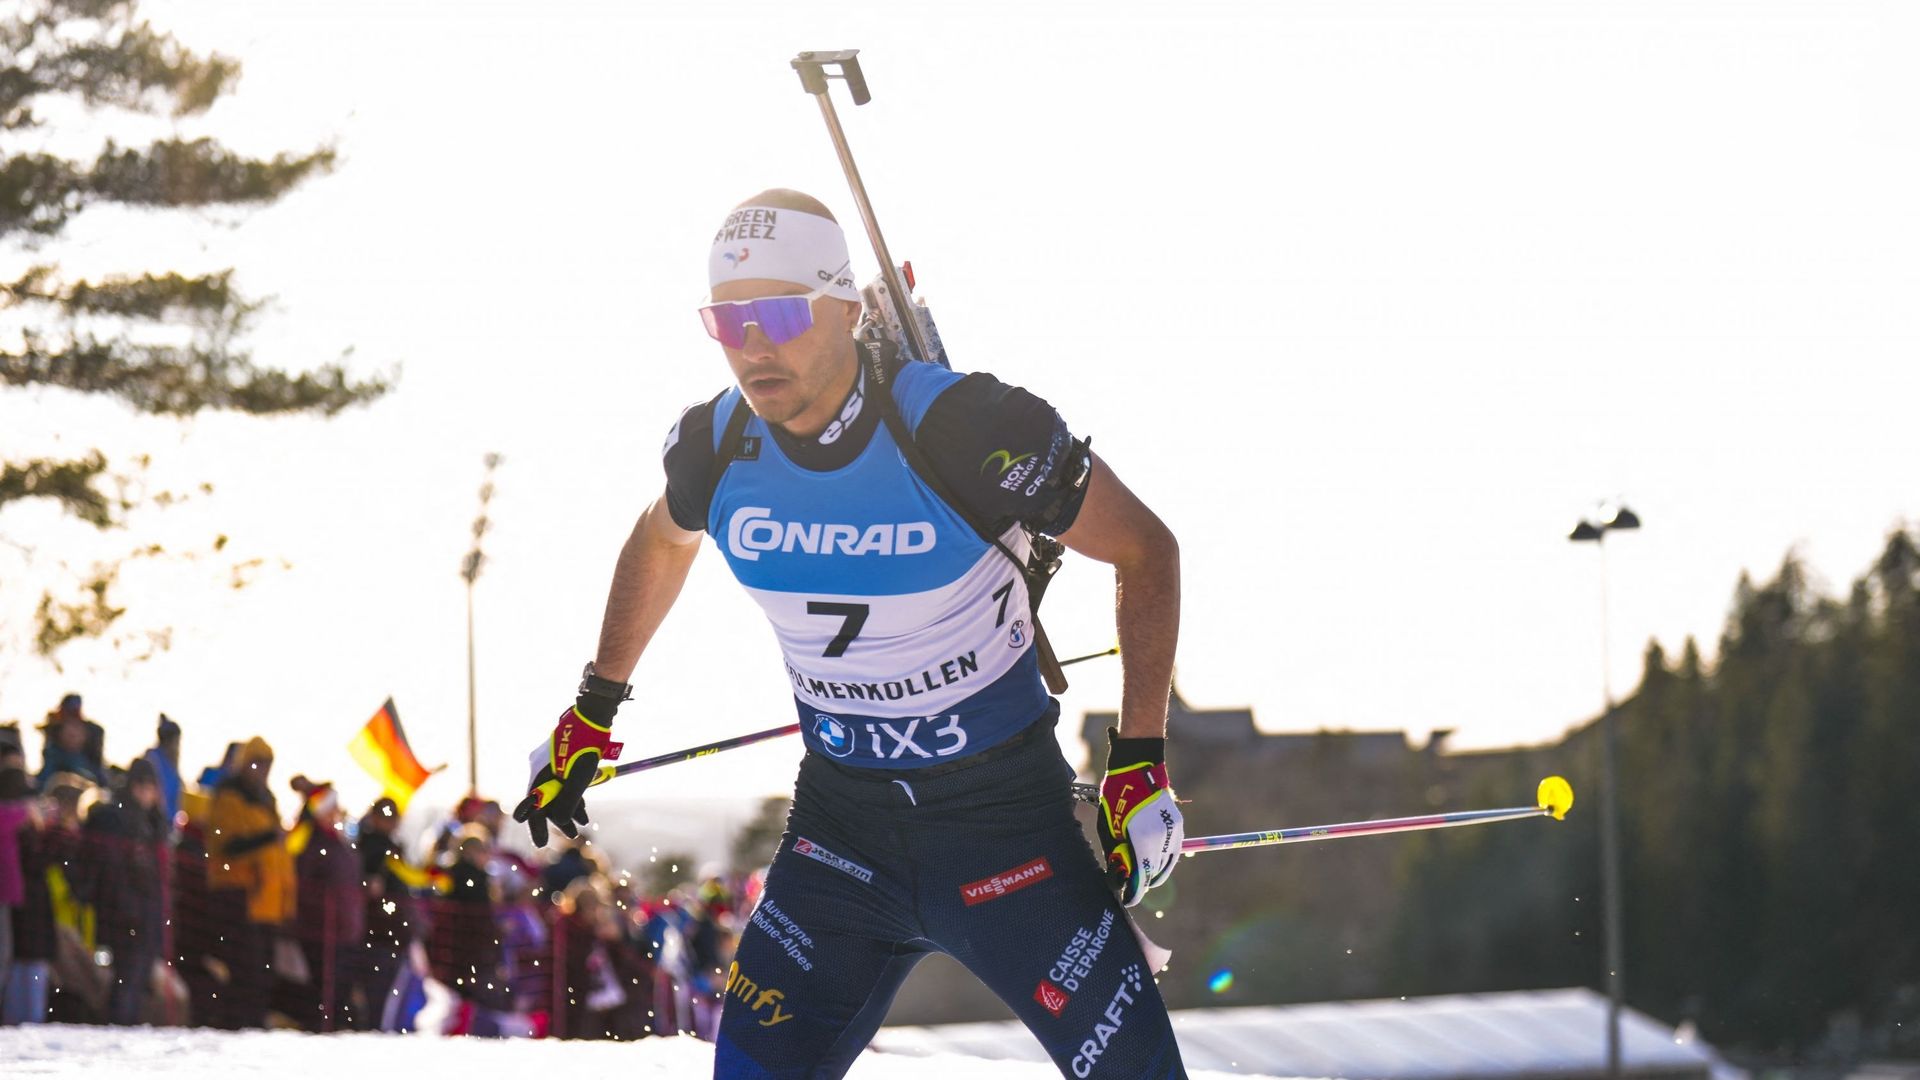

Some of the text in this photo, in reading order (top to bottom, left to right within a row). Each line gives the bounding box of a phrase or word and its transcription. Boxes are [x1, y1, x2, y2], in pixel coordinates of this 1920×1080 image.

[818, 362, 865, 445] es
[1000, 463, 1025, 489] ROY
[1010, 456, 1039, 492] ENERGIE
[727, 506, 937, 562] CONRAD
[992, 577, 1015, 629] 7
[807, 601, 870, 658] 7
[784, 650, 980, 702] OLMENKOLLEN
[557, 724, 573, 772] LEKI
[865, 714, 968, 760] iX3
[1112, 784, 1134, 834] LEKI
[966, 863, 1045, 895] VIESSMANN
[751, 910, 813, 972] Rhône-Alpes
[762, 899, 814, 950] Auvergne-
[1062, 908, 1114, 993] D'EPARGNE
[1049, 927, 1093, 982] CAISSE
[725, 960, 794, 1027] omfy
[1071, 981, 1134, 1079] CRAFT
